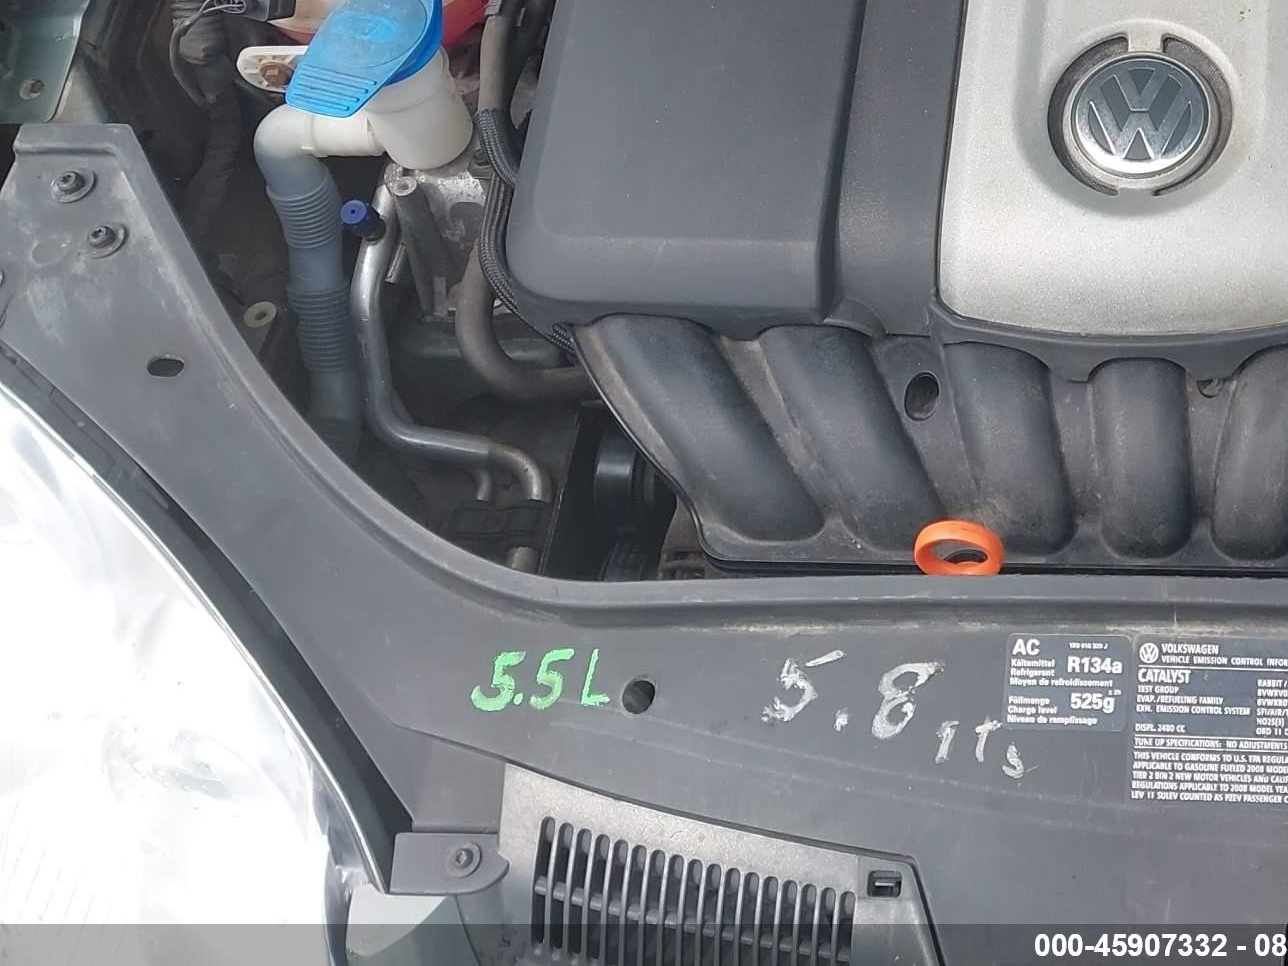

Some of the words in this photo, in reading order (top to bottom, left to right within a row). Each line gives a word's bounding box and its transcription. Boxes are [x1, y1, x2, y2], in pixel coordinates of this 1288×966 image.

[1076, 58, 1204, 175] VW
[1012, 638, 1040, 656] AC
[1161, 643, 1219, 654] VOLKSWAGEN
[1011, 658, 1055, 667] Kältemittel
[1067, 656, 1123, 674] R134a
[1161, 655, 1190, 664] VEHICLE
[1193, 656, 1228, 665] EMISSION
[1230, 658, 1263, 666] CONTROL
[1010, 668, 1055, 677] Refrigerant
[1138, 668, 1192, 683] CATALYST
[1010, 677, 1037, 686] Moyen
[1039, 678, 1049, 686] de
[1051, 678, 1113, 687] refroidissement
[1138, 685, 1153, 693] TEST
[1154, 685, 1179, 694] GROUP
[1008, 696, 1050, 706] Füllmenge
[1071, 693, 1115, 714] 525g
[1199, 696, 1223, 705] FAMILY
[1007, 706, 1036, 715] Charge
[1038, 706, 1057, 714] level
[1156, 705, 1189, 713] EMISSION
[1191, 706, 1222, 714] CONTROL
[1224, 707, 1250, 715] SYSTEM
[1007, 714, 1035, 723] Niveau
[1037, 715, 1048, 723] de
[1049, 716, 1098, 725] remplissage
[1135, 723, 1156, 732] DISPL.
[1176, 724, 1186, 732] CC
[1134, 737, 1152, 745] TUNE
[1155, 738, 1165, 746] UP
[1226, 740, 1237, 748] NO
[1239, 741, 1288, 750] ADJUSTMENTS
[1134, 752, 1150, 760] THIS
[1151, 752, 1179, 760] VEHICLE
[1181, 753, 1220, 761] CONFORMS
[1223, 754, 1232, 762] TO
[1133, 762, 1172, 770] APPLICABLE
[1185, 763, 1218, 771] GASOLINE
[1247, 765, 1264, 773] 2008
[1132, 771, 1147, 779] TIER
[1155, 772, 1167, 780] BIN
[1175, 772, 1192, 780] NEW
[1194, 773, 1218, 781] MOTOR
[1220, 774, 1251, 782] VEHICLES
[1253, 775, 1268, 783] AND
[1132, 781, 1177, 789] REGULATIONS
[1179, 783, 1217, 791] APPLICABLE
[1249, 785, 1273, 793] MODEL
[1131, 791, 1144, 799] LEV
[1157, 791, 1178, 800] SULEV
[1180, 792, 1212, 801] COUNTED
[1214, 793, 1223, 801] AS
[1244, 794, 1282, 803] PASSENGER
